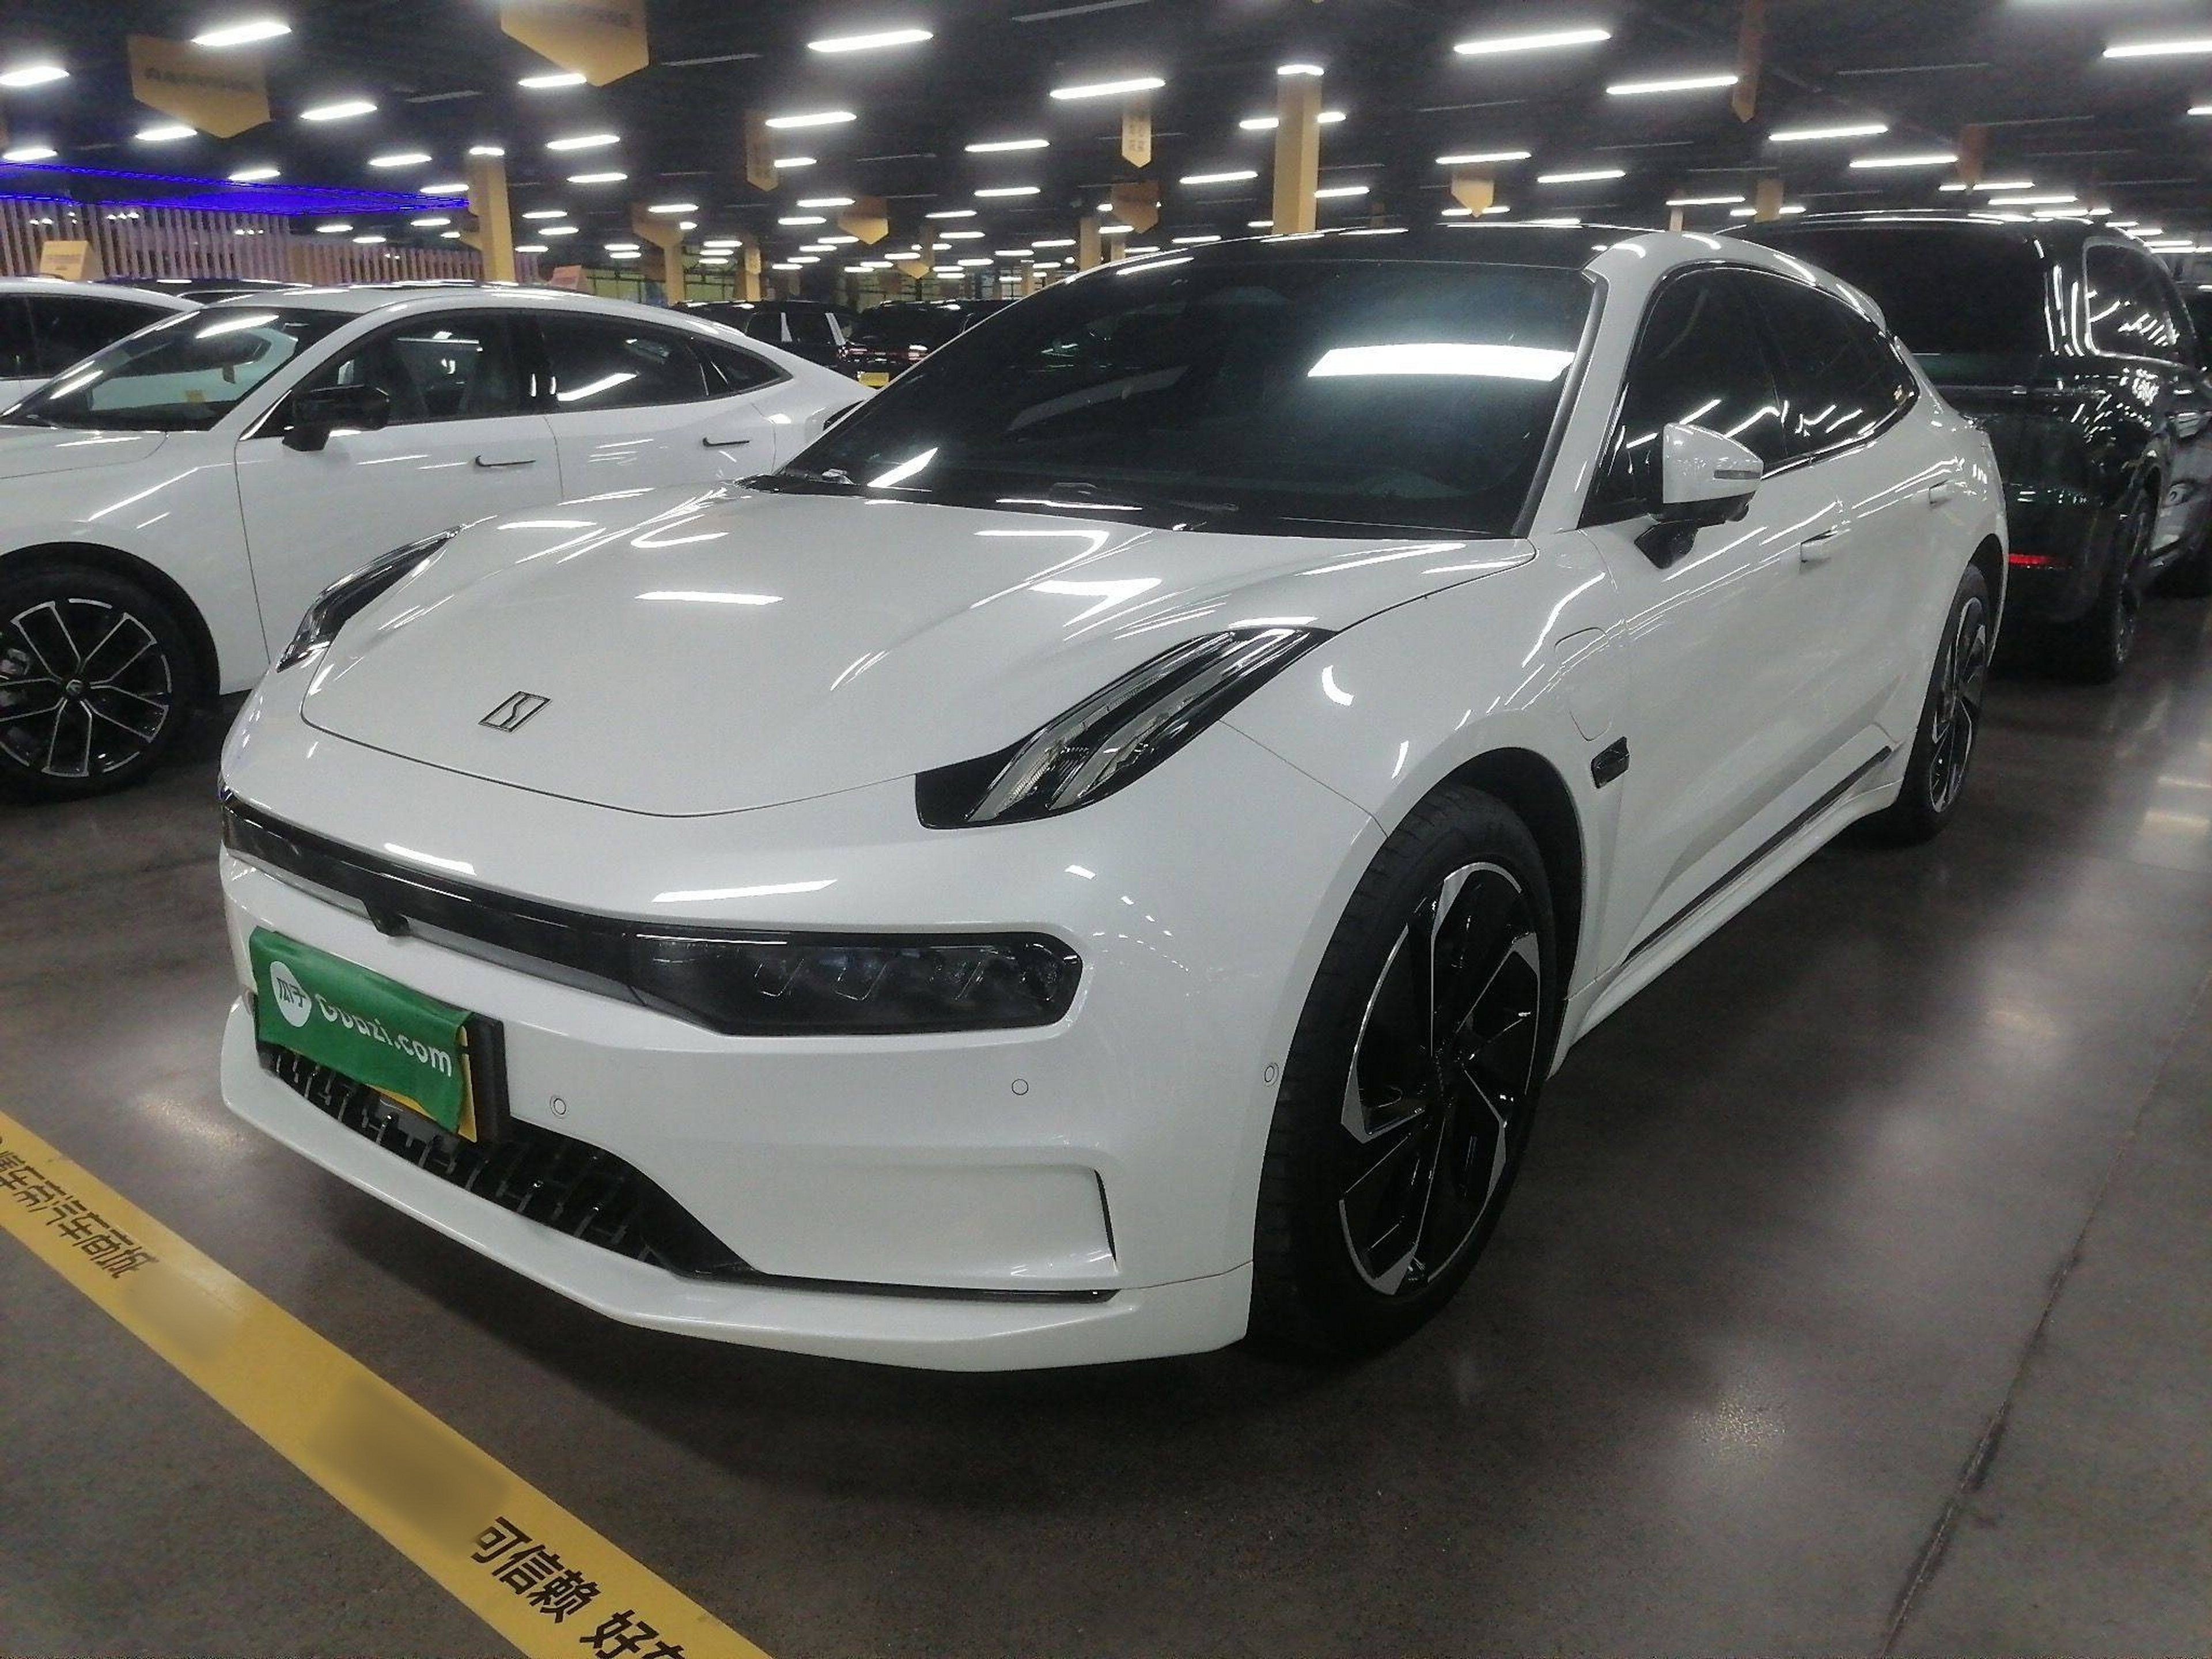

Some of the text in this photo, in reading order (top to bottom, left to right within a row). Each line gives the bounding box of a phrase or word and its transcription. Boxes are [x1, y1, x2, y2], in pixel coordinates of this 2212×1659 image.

[276, 977, 307, 1008] 瓜子
[315, 994, 452, 1077] Guazi.com
[471, 1516, 601, 1623] 可信赖
